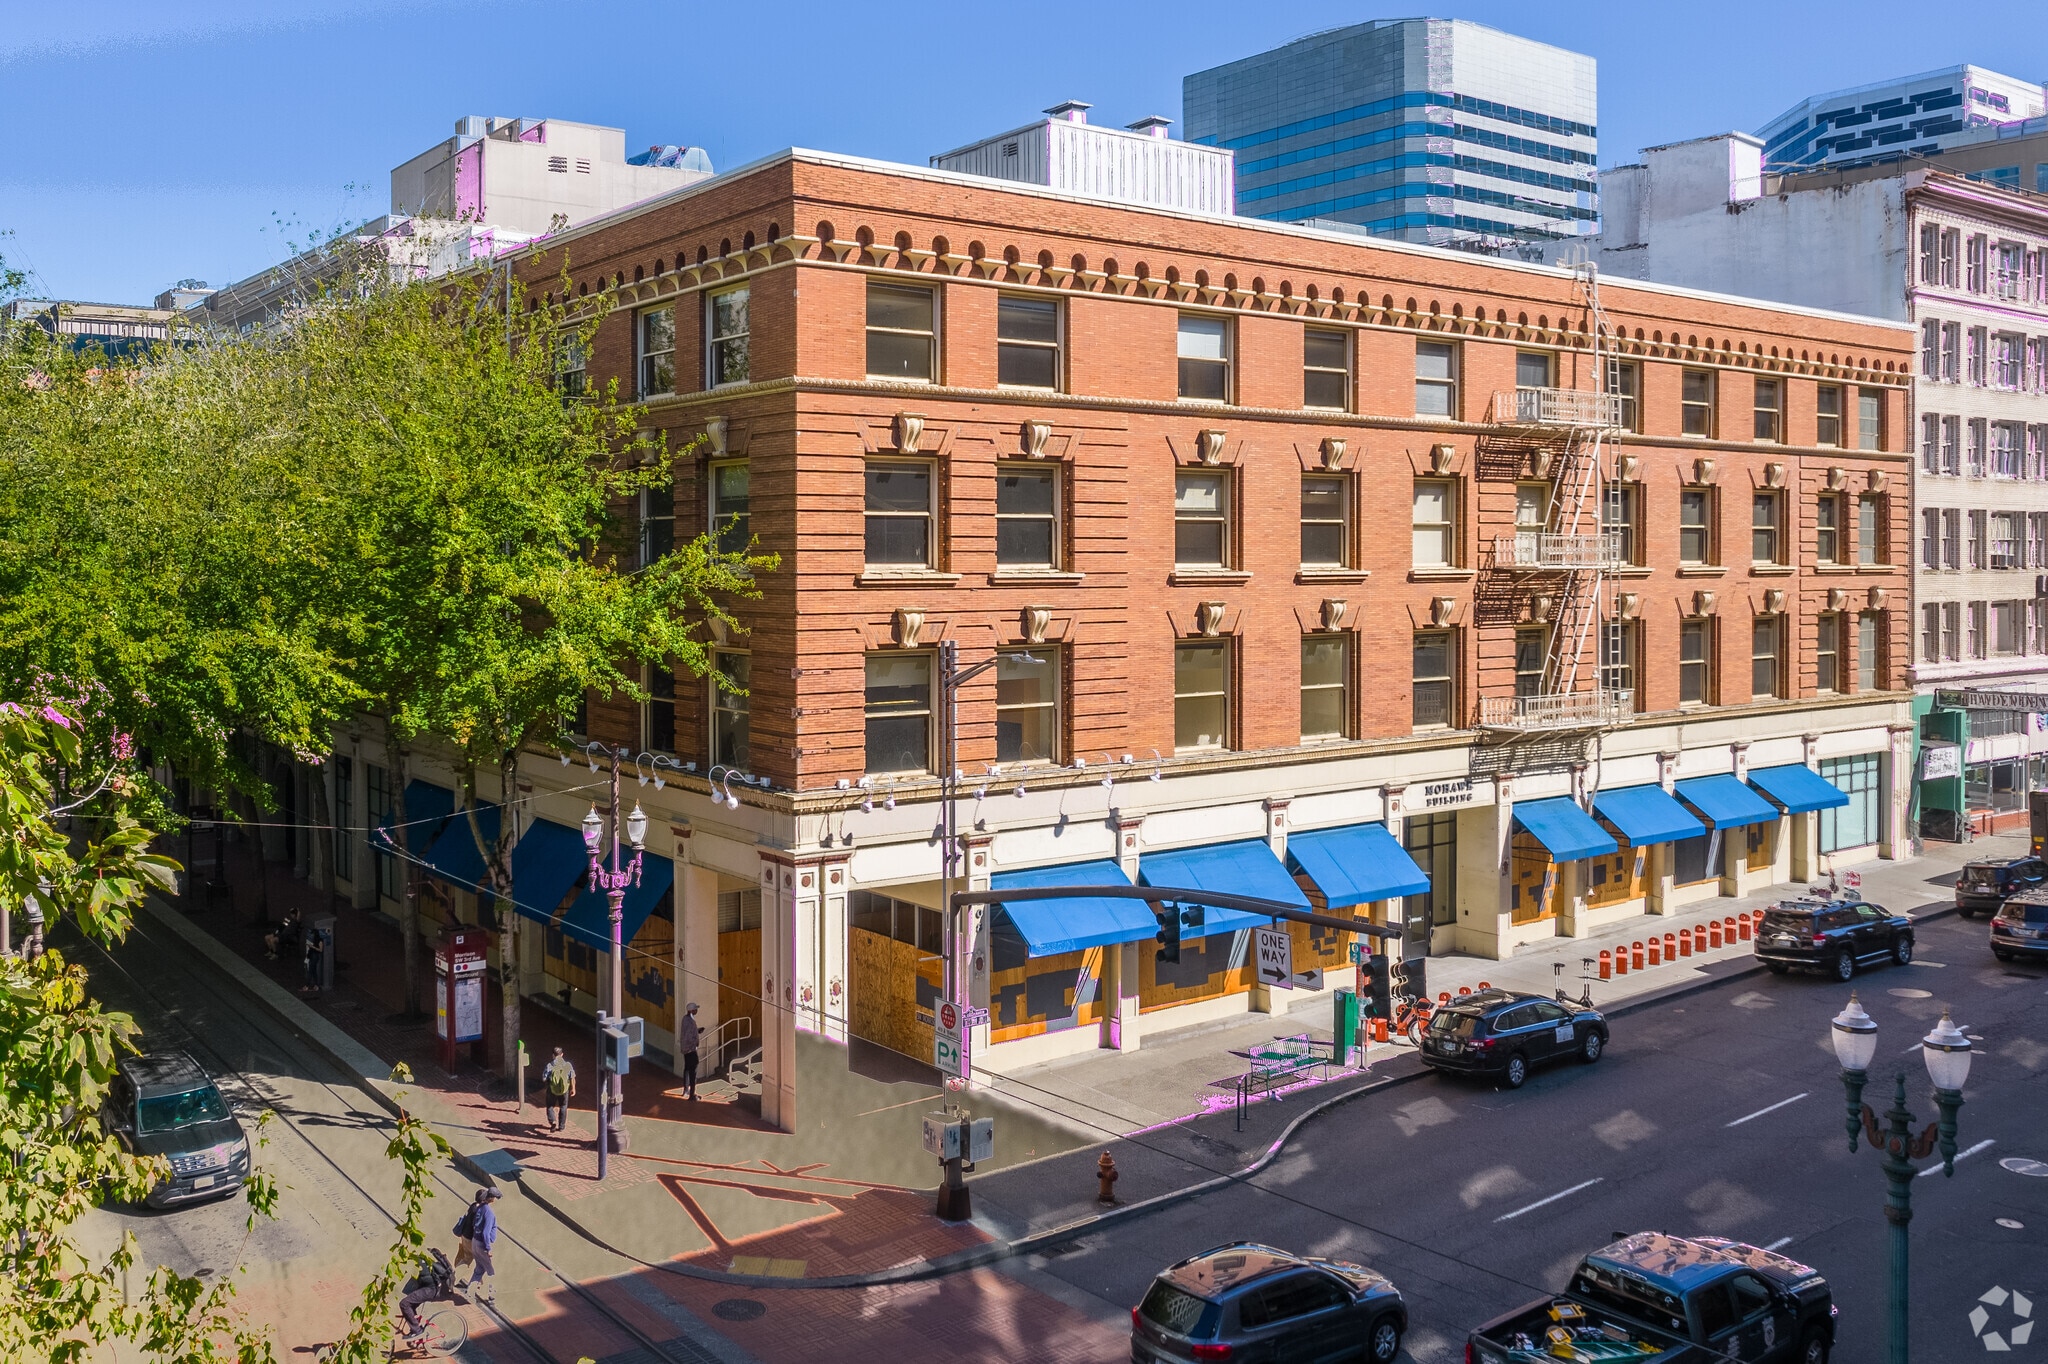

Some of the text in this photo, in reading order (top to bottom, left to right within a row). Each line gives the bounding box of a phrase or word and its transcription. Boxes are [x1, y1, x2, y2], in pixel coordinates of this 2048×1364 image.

[1425, 781, 1473, 796] MOHAWK
[1426, 793, 1472, 807] BUILDING
[1261, 933, 1285, 950] ONE
[1261, 947, 1286, 965] WAY
[455, 971, 479, 979] Westbound
